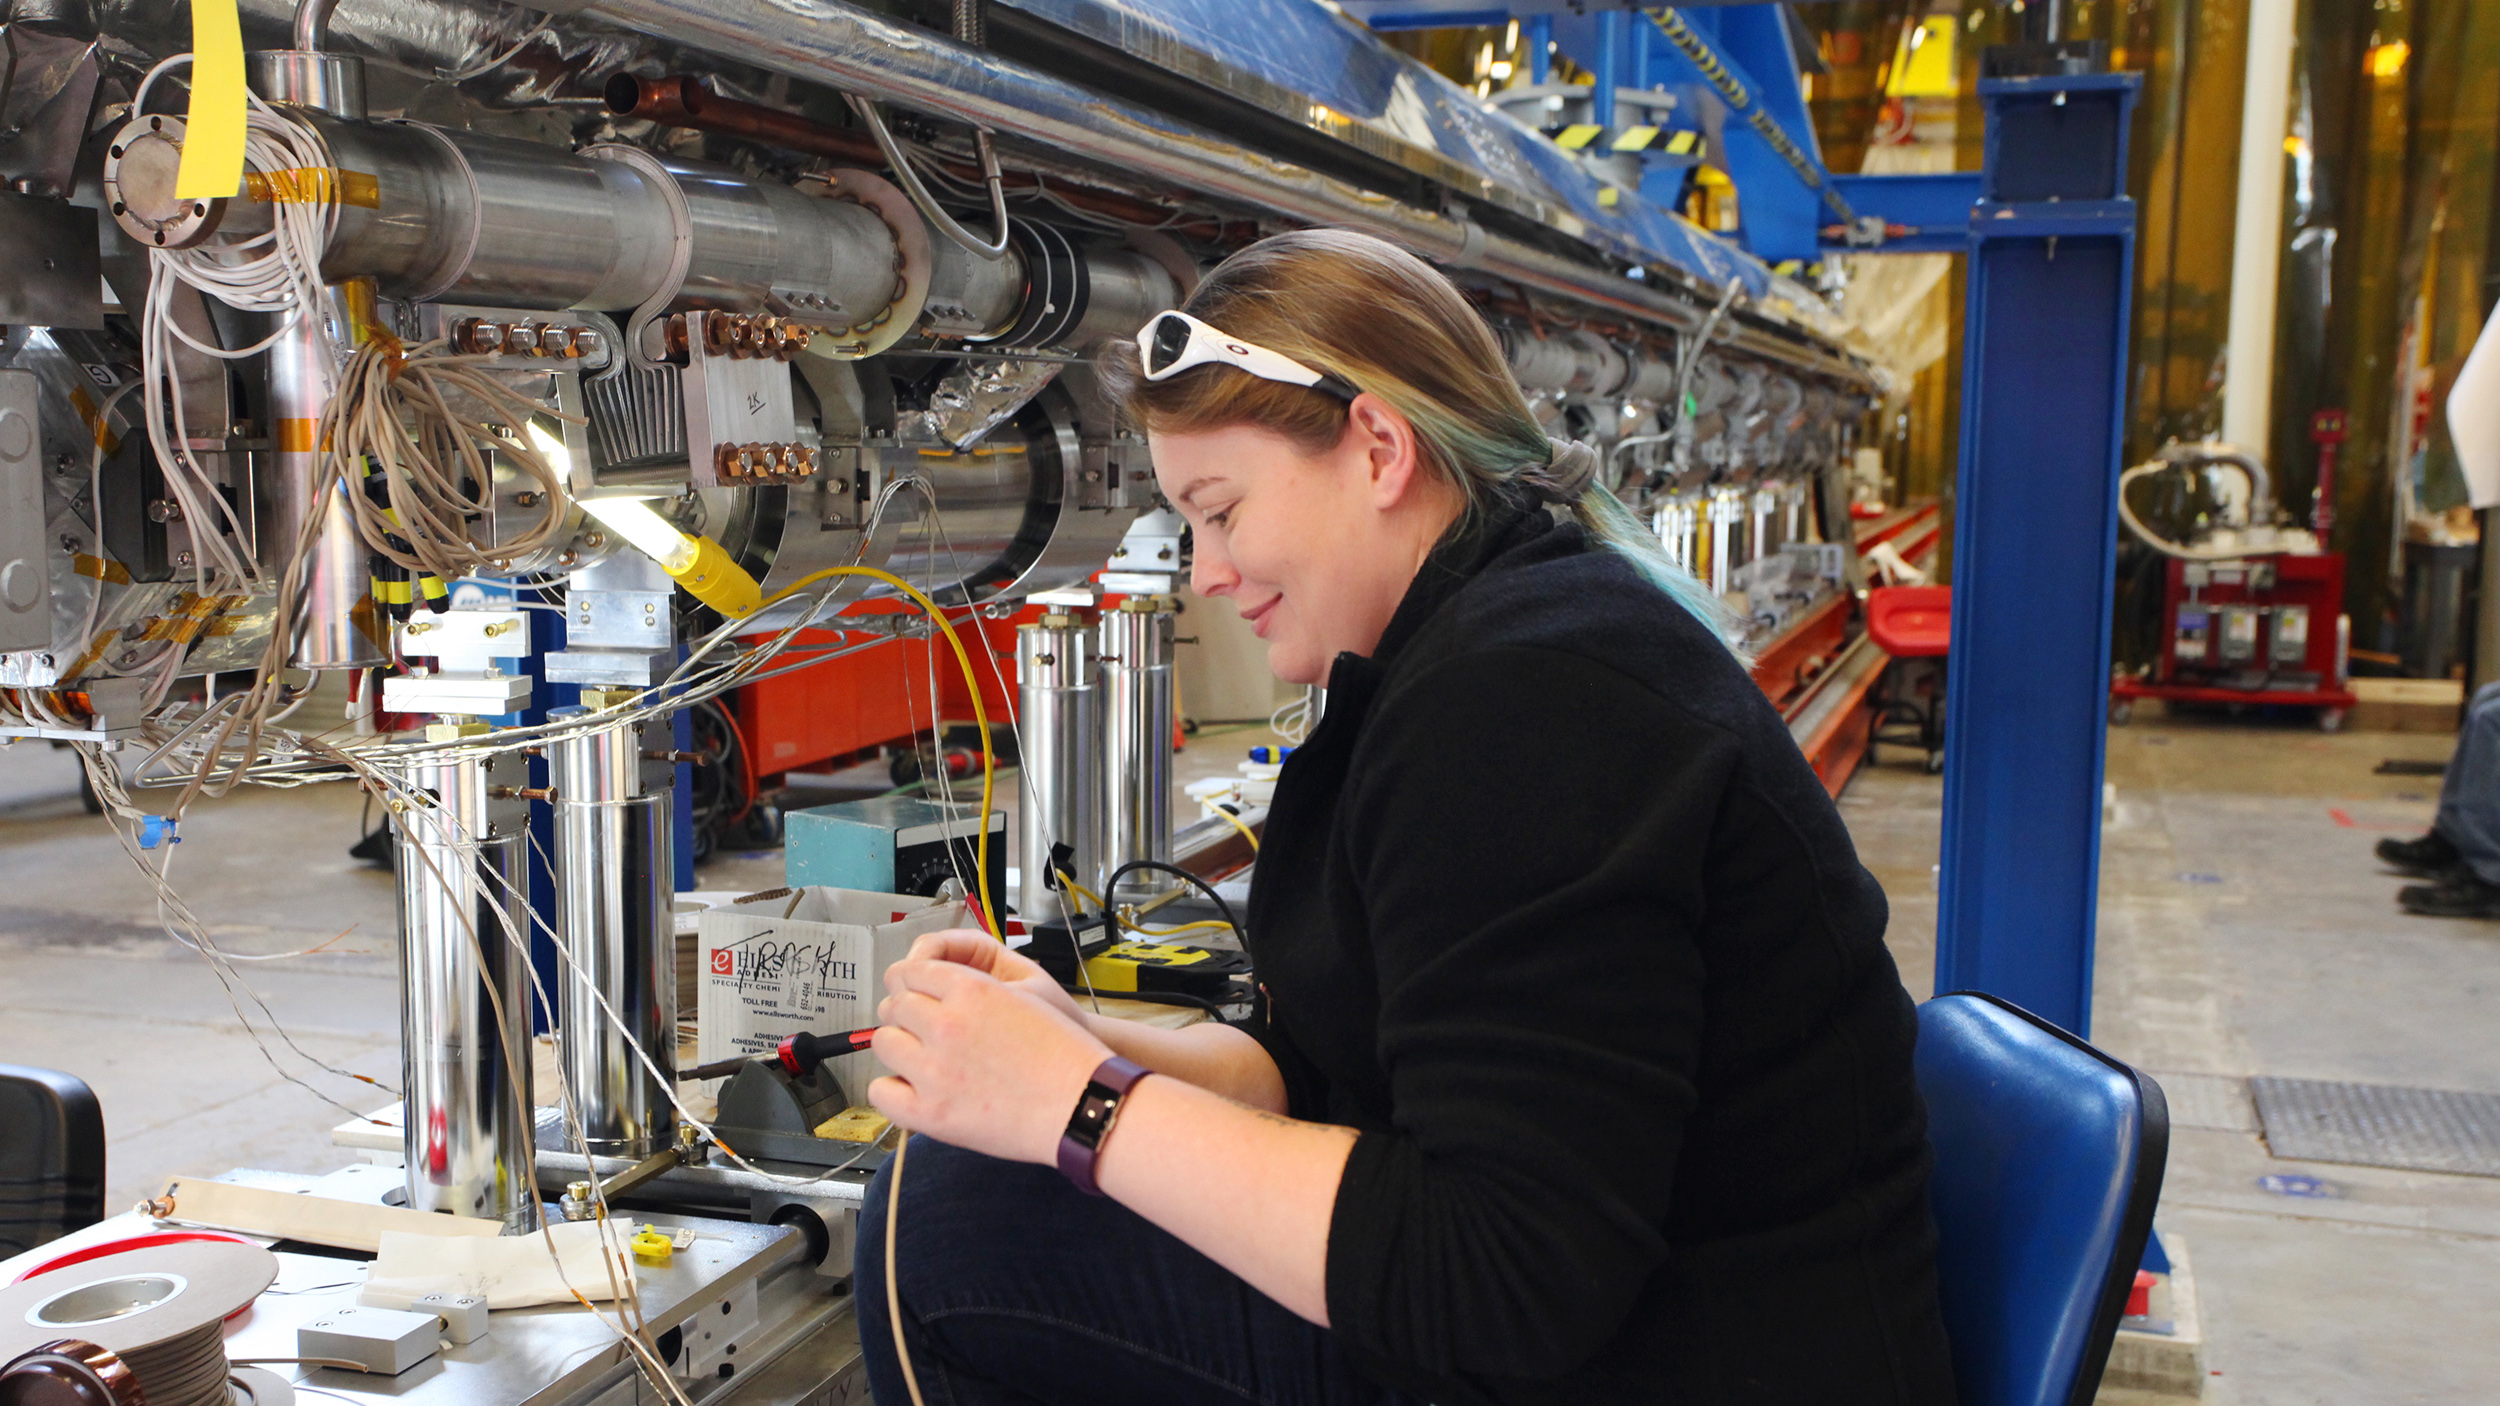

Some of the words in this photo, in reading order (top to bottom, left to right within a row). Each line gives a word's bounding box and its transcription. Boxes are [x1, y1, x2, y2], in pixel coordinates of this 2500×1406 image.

[737, 951, 857, 980] ELLSRTH
[742, 997, 760, 1006] TOLL
[761, 999, 778, 1008] FREE
[753, 1009, 814, 1021] www.ellsworth.com
[731, 1038, 767, 1048] ADHESIVES,
